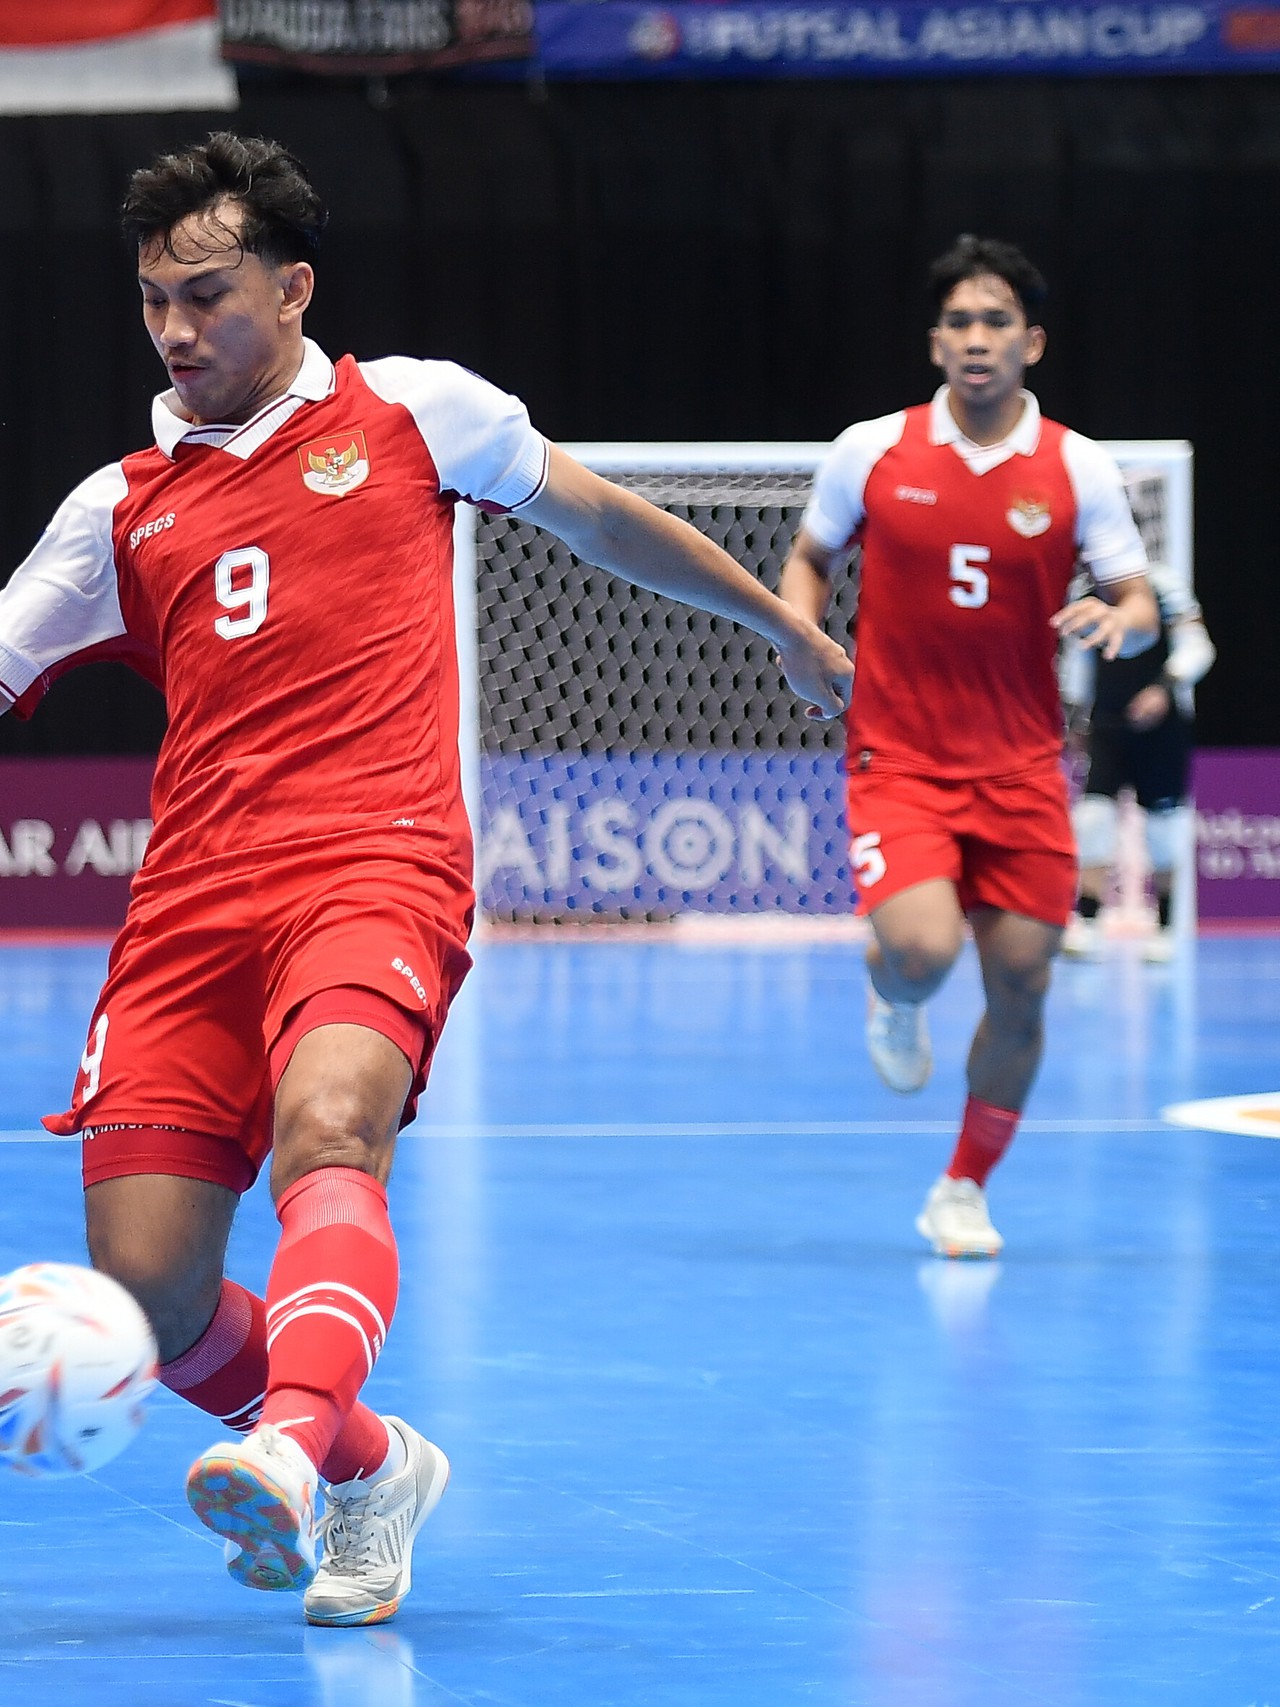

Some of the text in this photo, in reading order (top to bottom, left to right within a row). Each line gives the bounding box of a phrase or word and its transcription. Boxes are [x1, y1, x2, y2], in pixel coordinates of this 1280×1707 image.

[1091, 5, 1209, 57] CUP
[130, 512, 176, 550] SPECS
[214, 545, 270, 641] 9
[949, 542, 992, 609] 5
[849, 831, 888, 887] 5
[391, 957, 427, 1006] SPEC
[81, 1012, 110, 1105] 9
